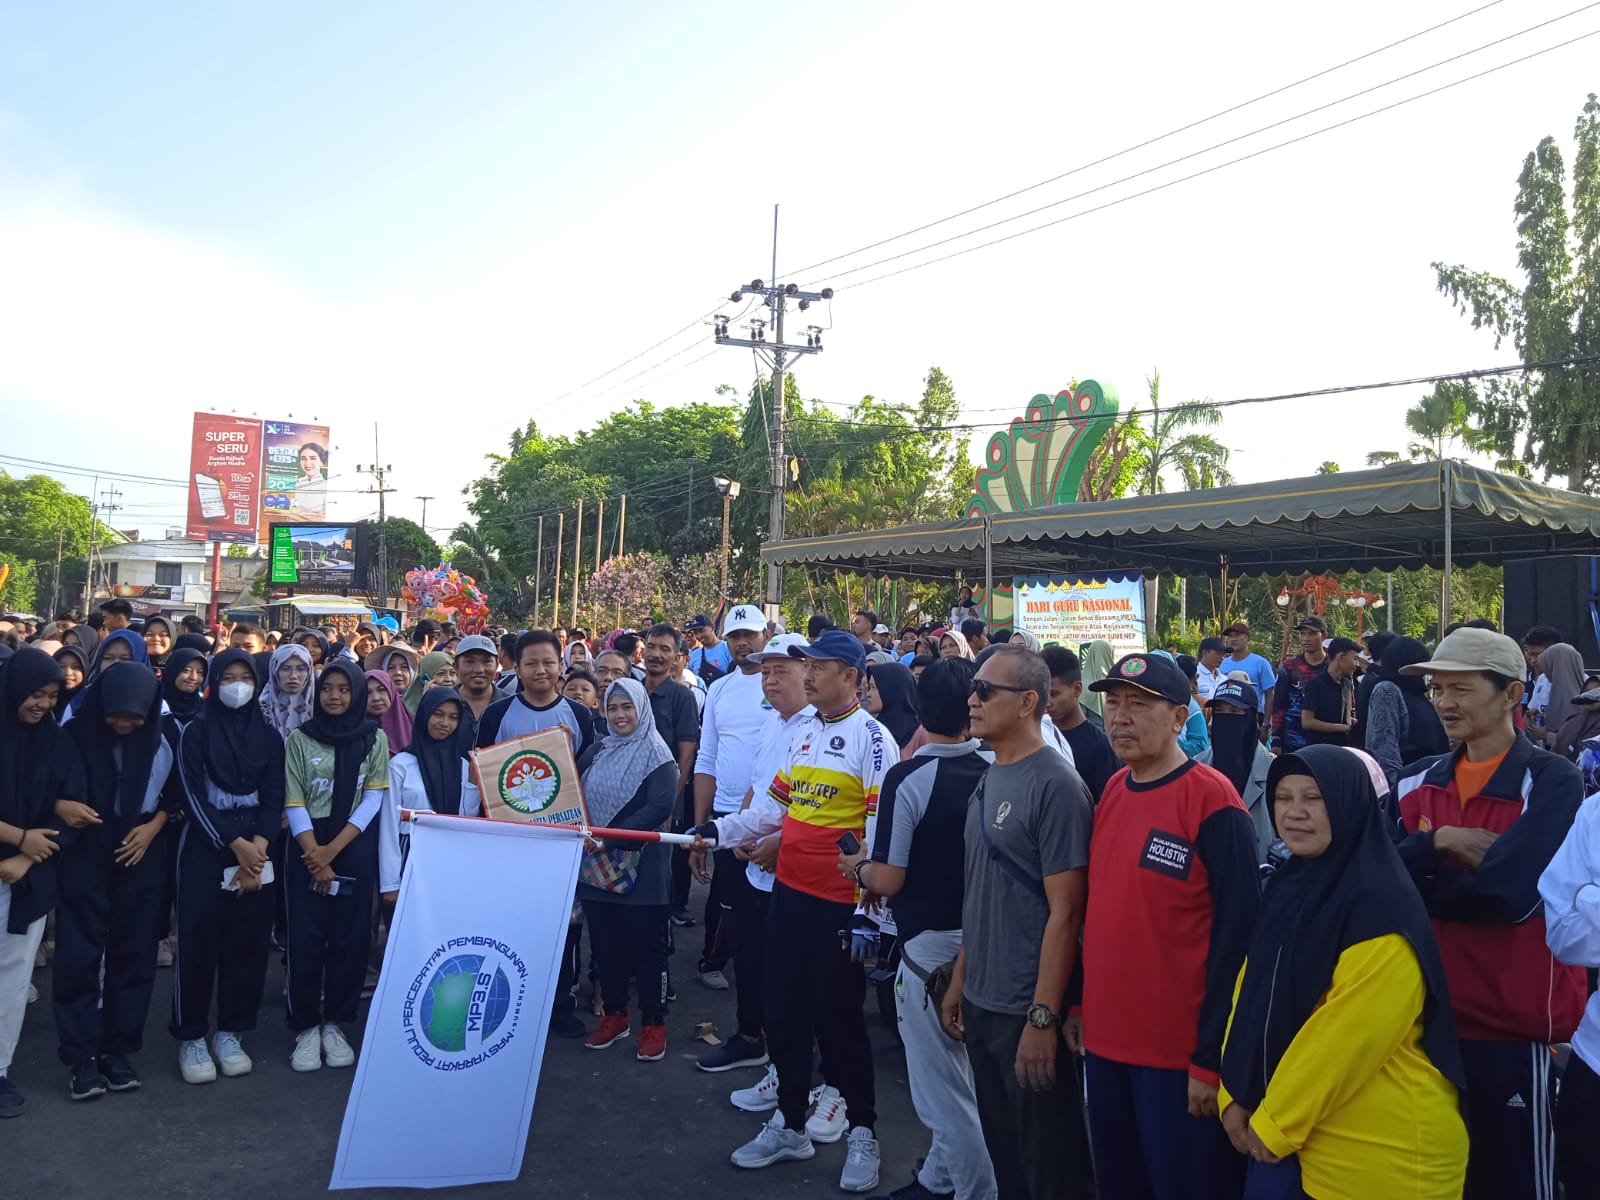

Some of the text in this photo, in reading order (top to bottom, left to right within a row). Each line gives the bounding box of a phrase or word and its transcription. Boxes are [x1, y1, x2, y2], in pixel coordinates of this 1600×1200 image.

[205, 431, 245, 442] SUPER
[216, 443, 249, 454] SERU
[1026, 598, 1133, 613] HARI GURU NASIONAL
[1107, 632, 1136, 640] SUMENEP
[1149, 842, 1187, 864] HOLISTIK
[403, 936, 529, 1072] MASYARAKAT PEDULI PERCEPATAN PEMBANGUNAN
